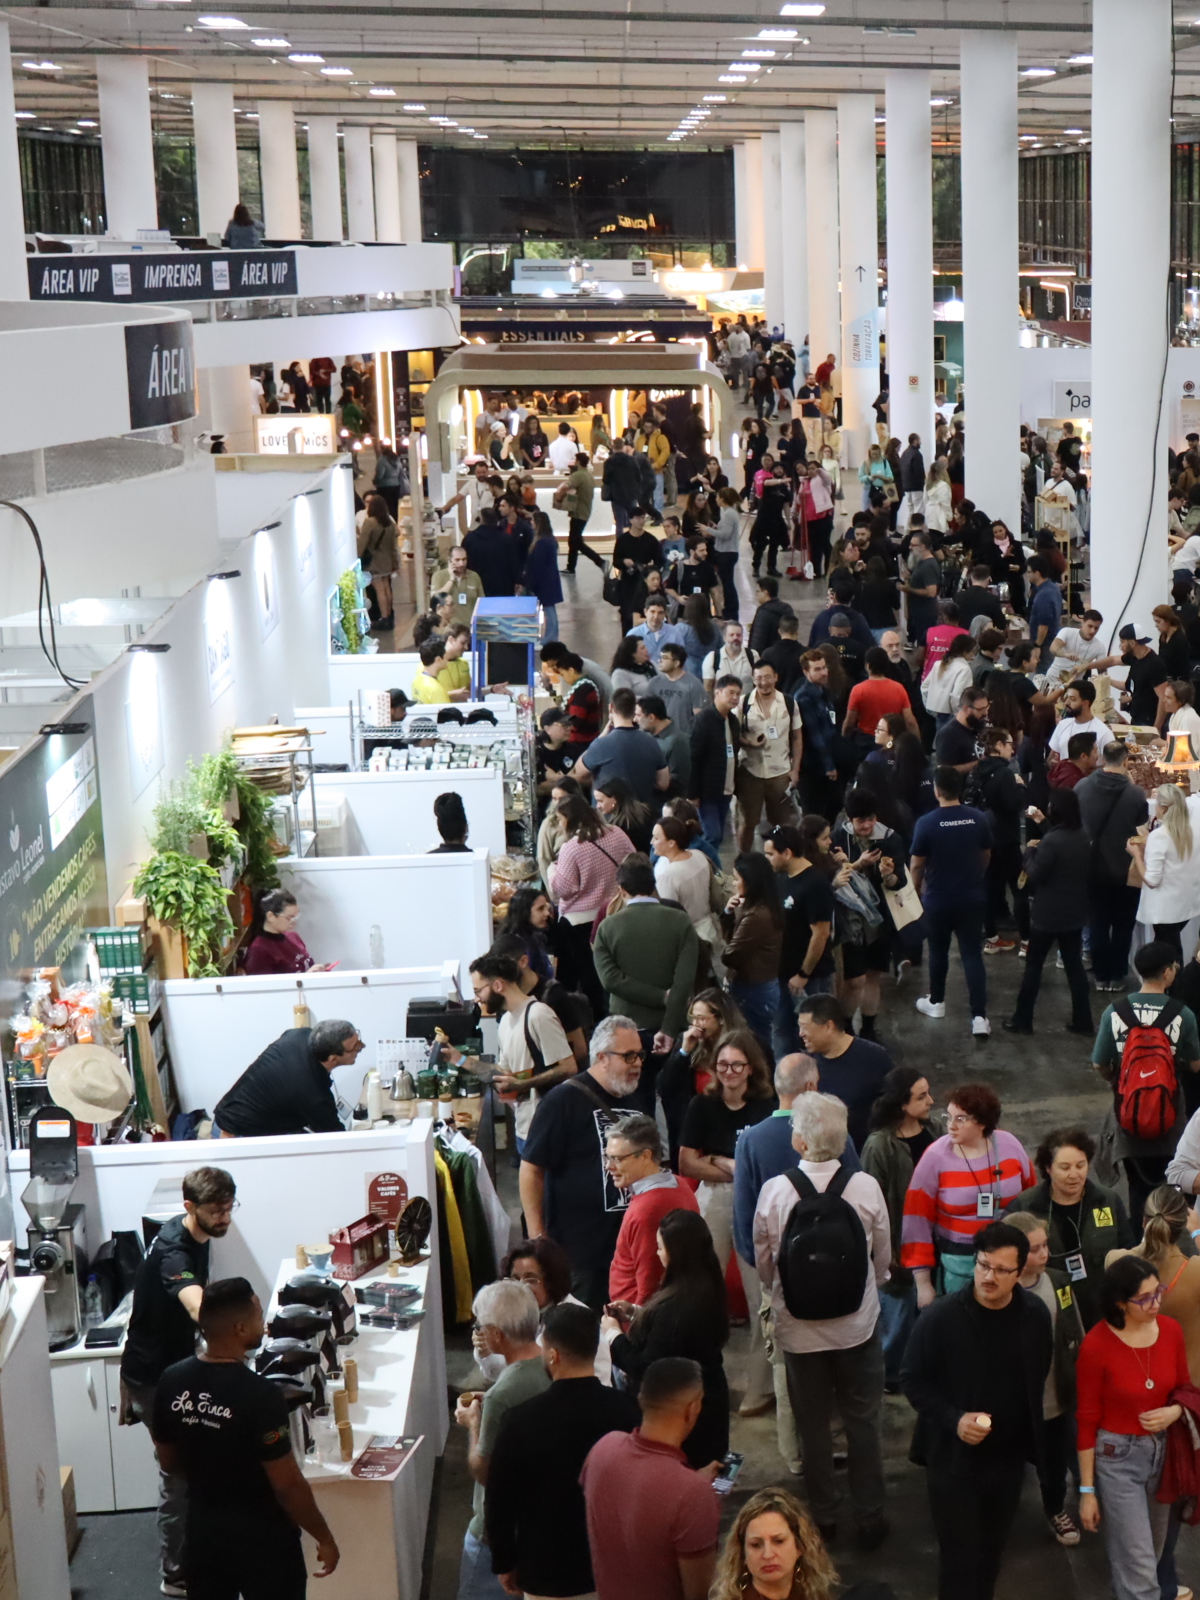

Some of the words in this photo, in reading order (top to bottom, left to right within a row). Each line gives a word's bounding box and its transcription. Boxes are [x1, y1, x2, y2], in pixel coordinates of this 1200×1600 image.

[41, 266, 74, 295] ÁREA
[79, 268, 100, 293] VIP
[144, 264, 202, 288] IMPRENSA
[241, 260, 269, 286] ÁREA
[271, 262, 288, 284] VIP
[853, 334, 861, 362] COZINHA
[147, 344, 187, 399] ÁREA
[940, 818, 976, 827] COMERCIAL
[21, 823, 44, 871] Leonel
[170, 1390, 195, 1414] La
[197, 1391, 233, 1419] Finca
